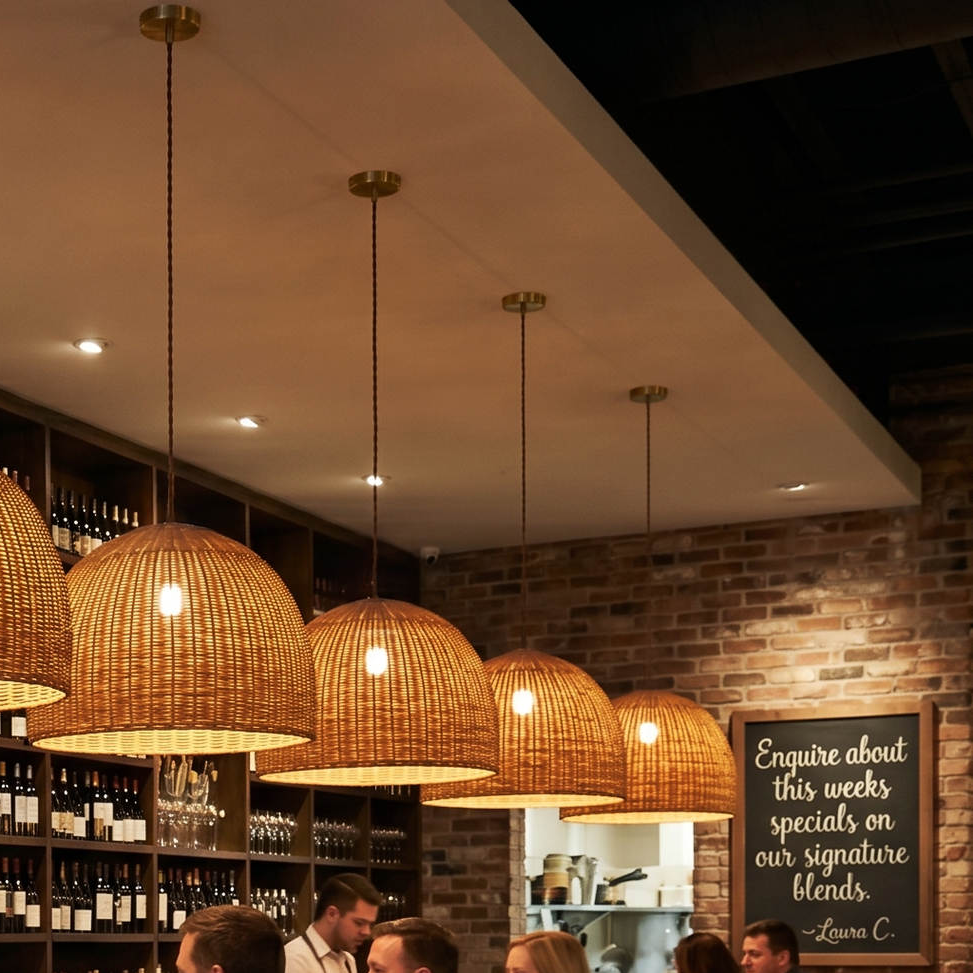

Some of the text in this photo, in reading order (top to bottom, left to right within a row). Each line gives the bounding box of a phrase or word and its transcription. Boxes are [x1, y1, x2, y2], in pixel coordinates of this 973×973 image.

[754, 734, 908, 778] Enquire about
[772, 769, 892, 802] this weeks
[770, 802, 896, 845] specials on
[755, 838, 910, 878] our signature
[792, 872, 871, 903] blends.
[872, 916, 895, 942] C.
